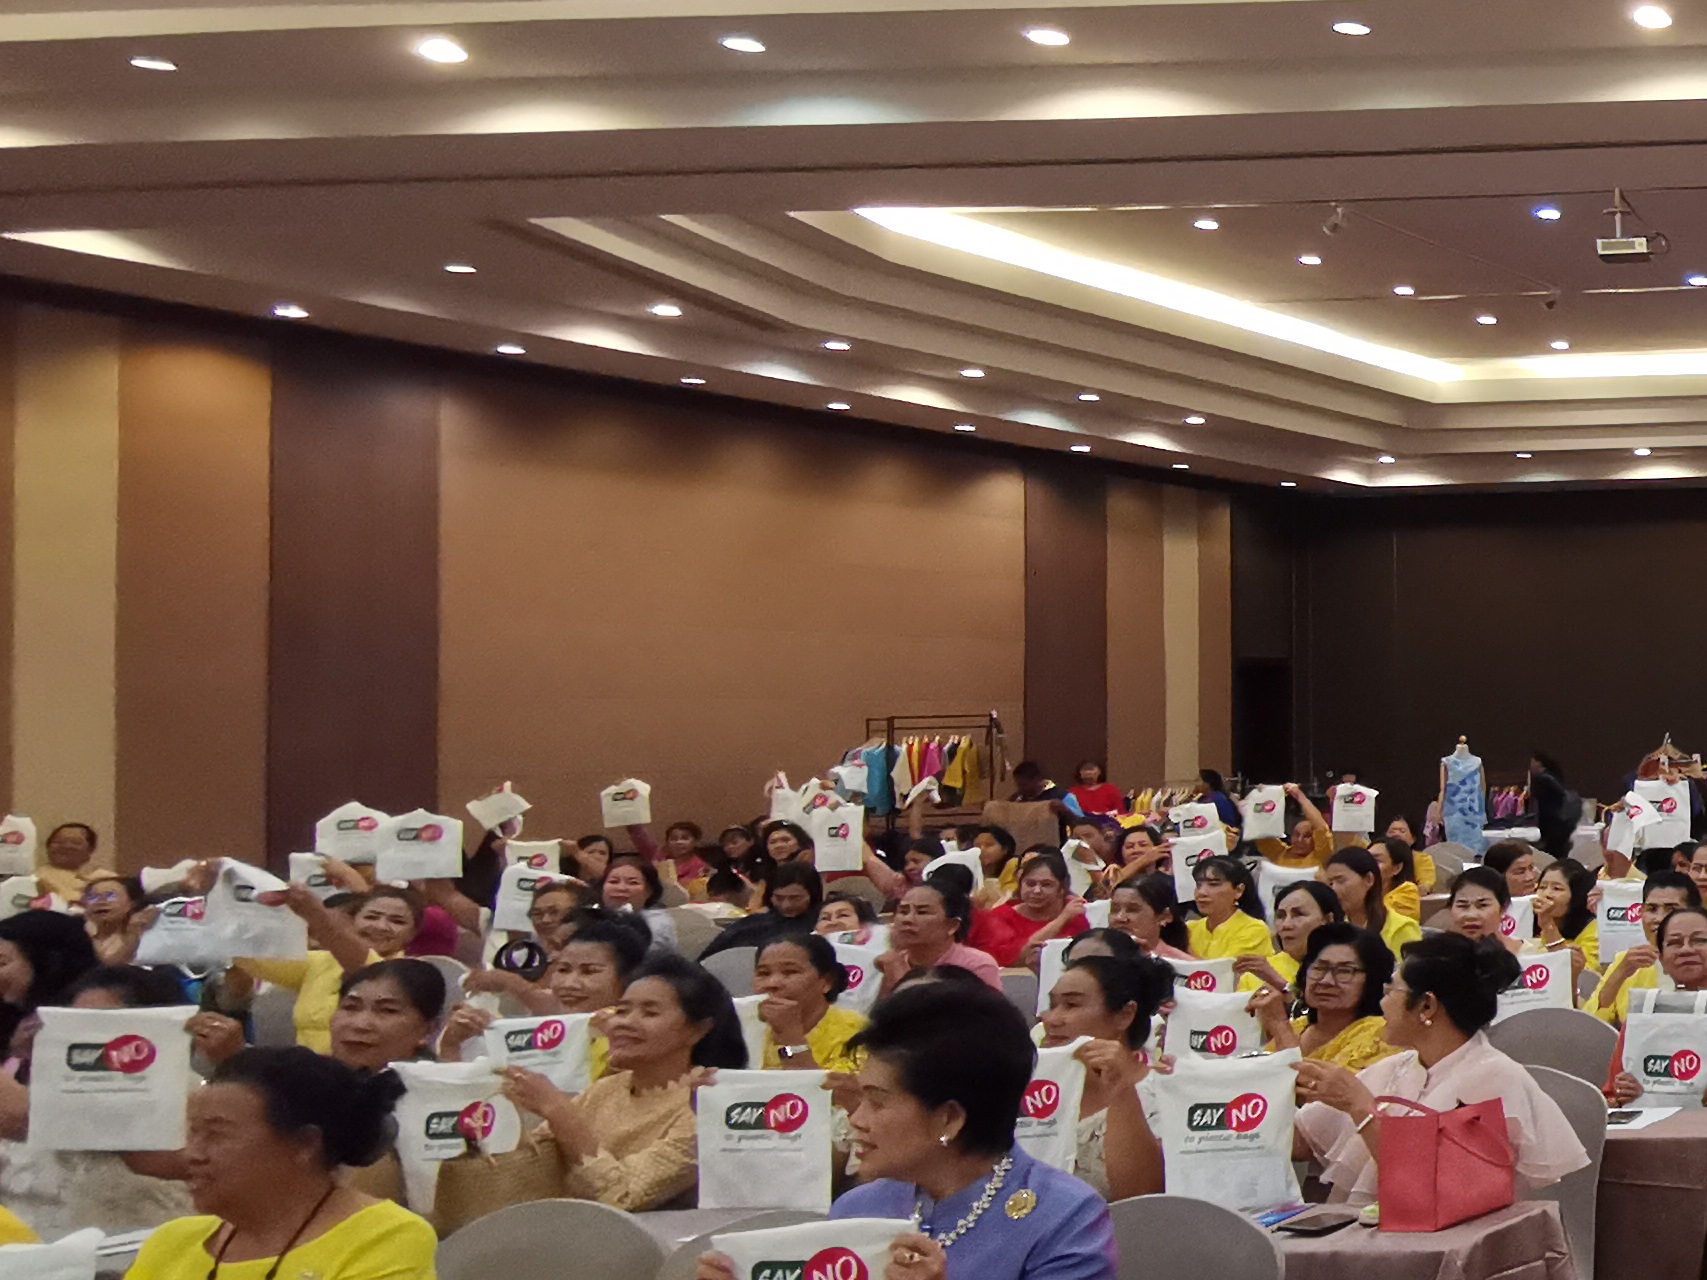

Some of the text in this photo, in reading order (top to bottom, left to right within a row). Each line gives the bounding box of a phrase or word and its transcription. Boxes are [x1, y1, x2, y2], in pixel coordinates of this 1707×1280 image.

[1526, 967, 1547, 985] NO
[537, 1022, 563, 1046] NO
[1210, 1030, 1234, 1051] NO
[1647, 1054, 1697, 1076] SAY NO
[1025, 1084, 1058, 1115] NO
[728, 1099, 803, 1127] SAY NO
[1191, 1097, 1263, 1127] SAY NO
